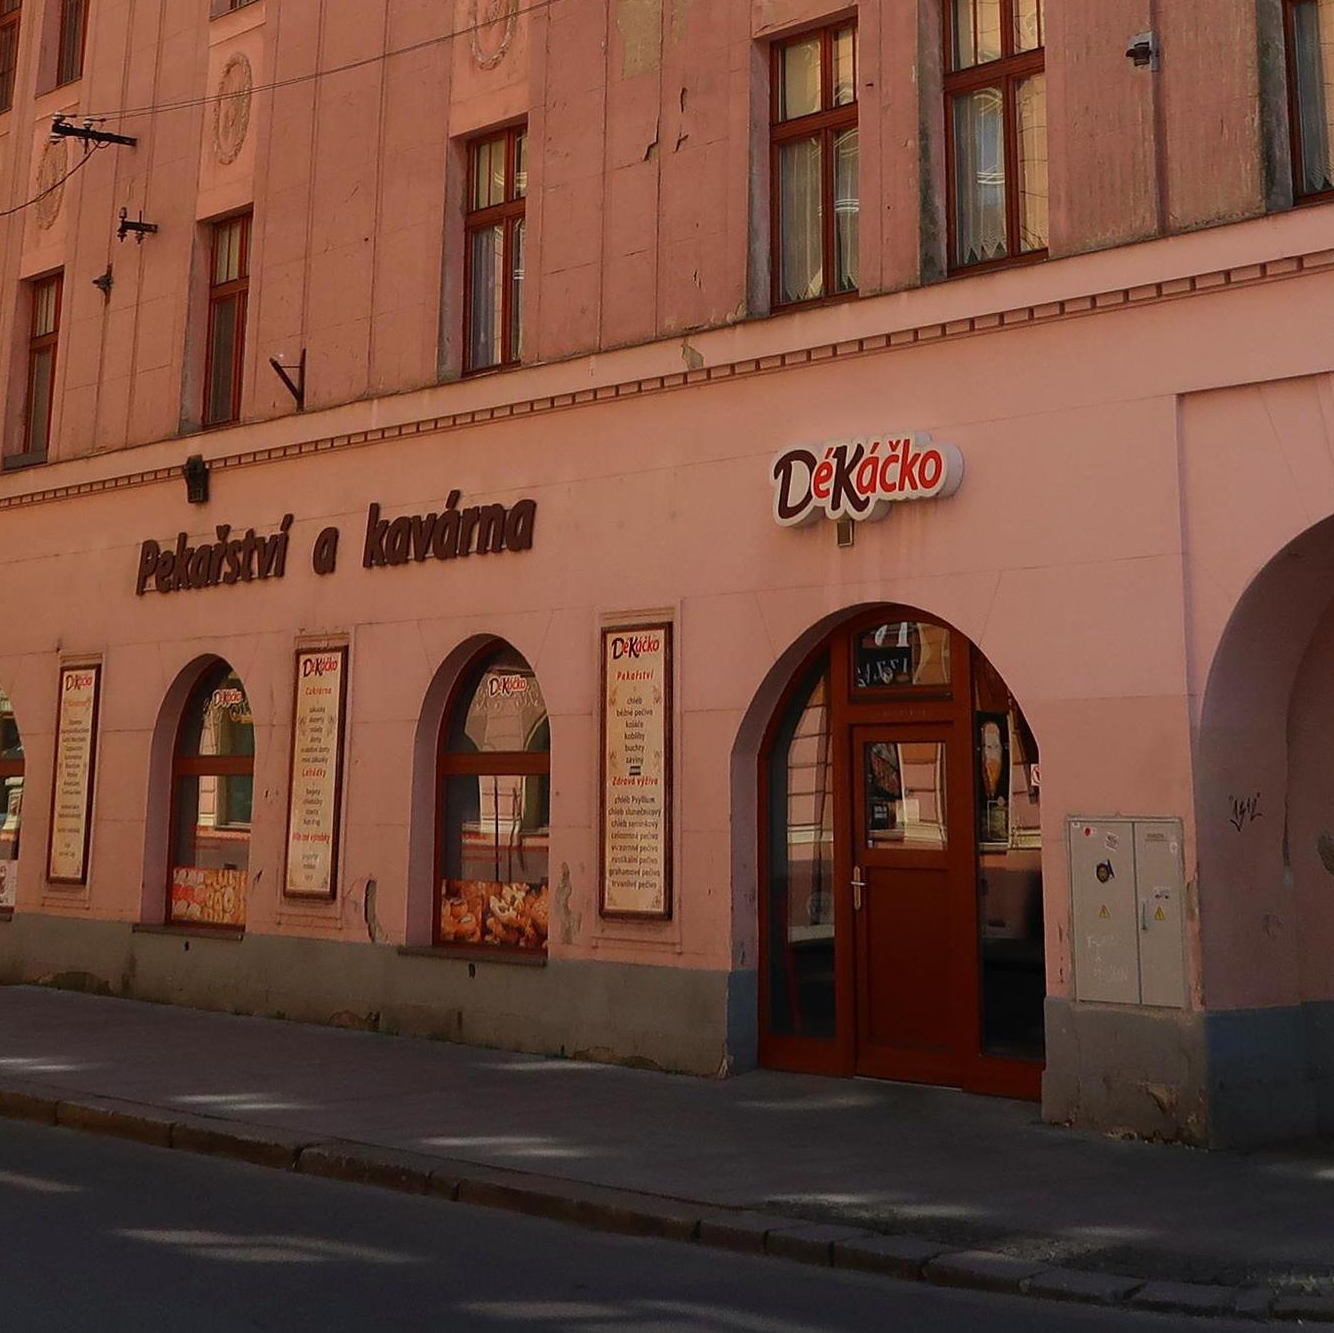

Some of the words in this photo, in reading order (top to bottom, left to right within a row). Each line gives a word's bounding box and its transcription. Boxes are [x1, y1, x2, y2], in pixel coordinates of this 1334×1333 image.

[773, 438, 943, 519] DéKáčko
[136, 513, 295, 596] Pekařství
[313, 527, 340, 575] a
[363, 489, 537, 568] kavárna
[612, 635, 660, 660] DéKáčko
[303, 656, 338, 678] DéKáčko
[617, 669, 654, 681] Pekařství
[634, 709, 653, 718] pečivo
[624, 732, 645, 741] koblihy
[625, 743, 645, 753] buchty
